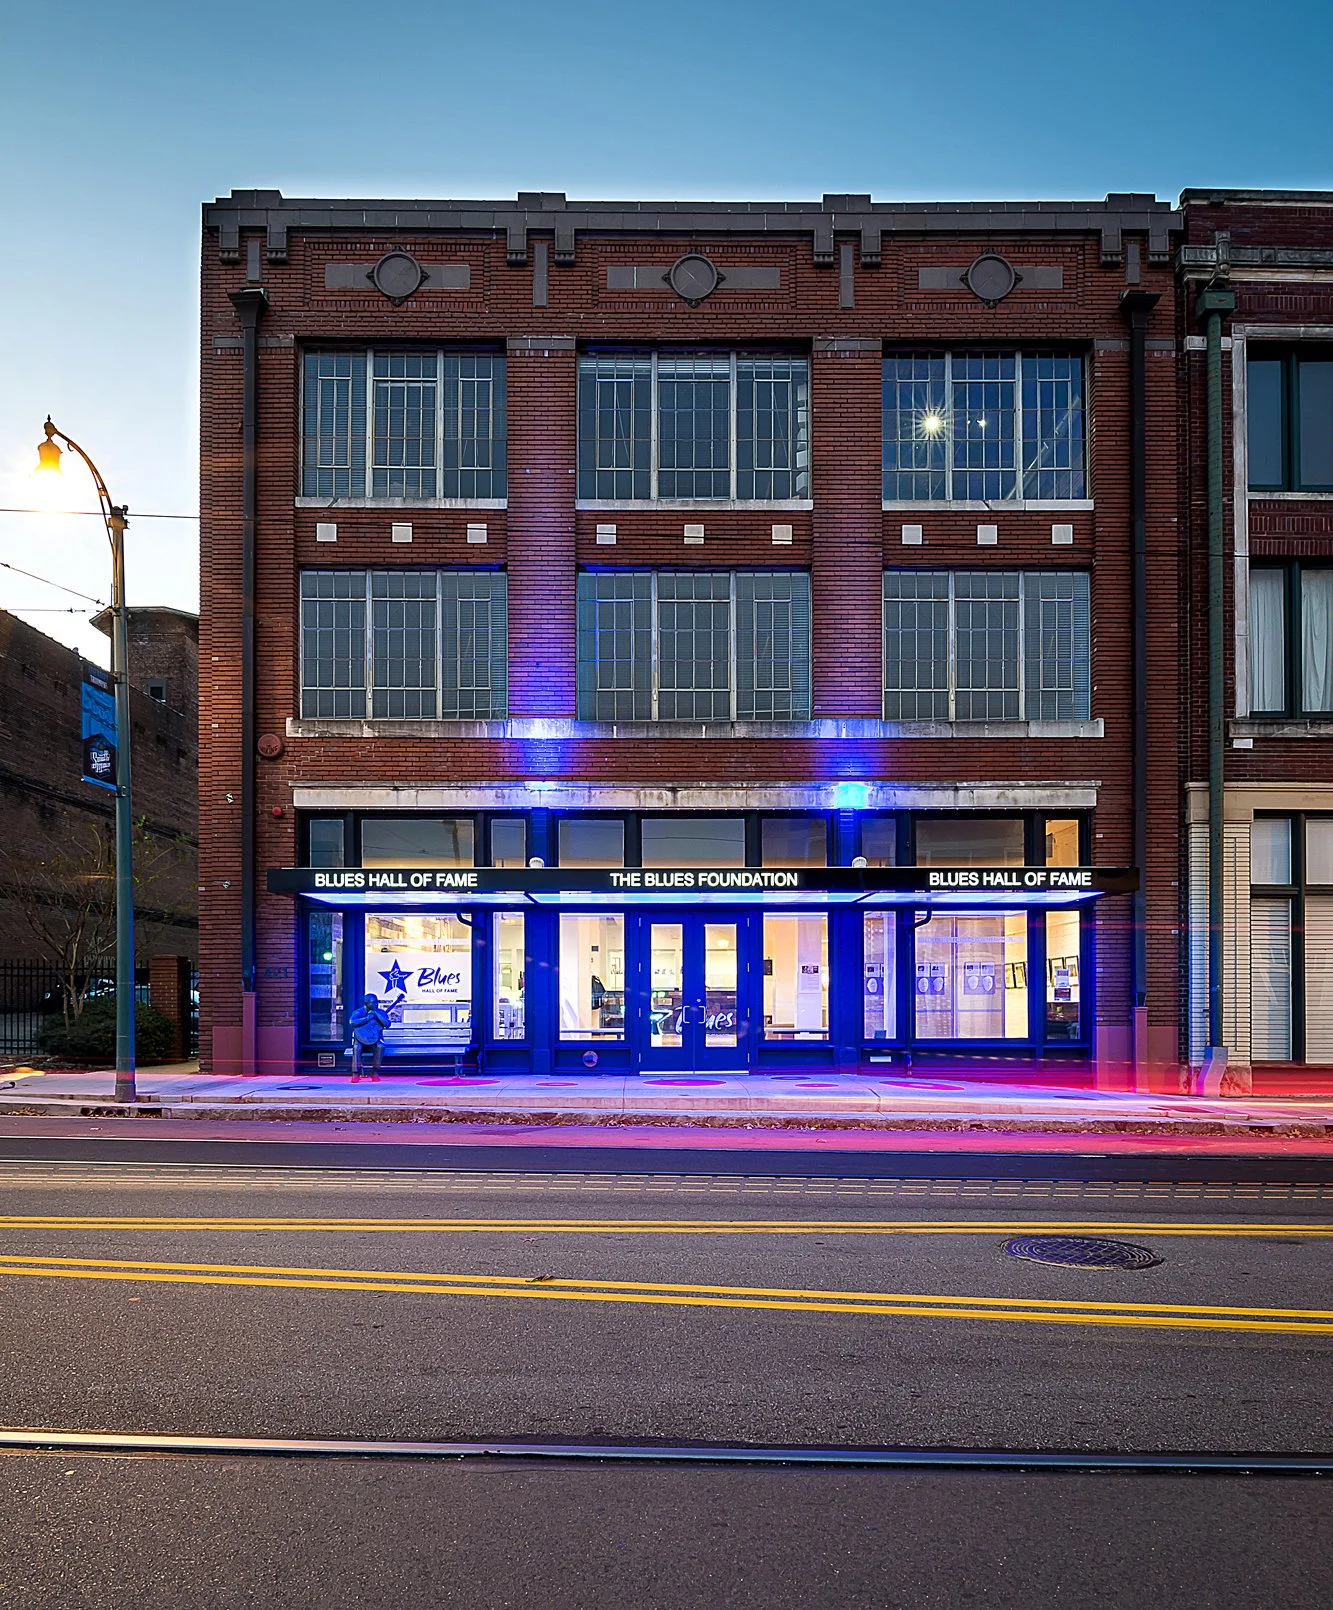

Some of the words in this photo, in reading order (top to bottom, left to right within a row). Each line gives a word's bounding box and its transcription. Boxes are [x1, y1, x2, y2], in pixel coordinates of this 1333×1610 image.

[315, 873, 365, 887] BLUES
[369, 873, 407, 887] HALL
[410, 873, 432, 887] OF
[436, 873, 477, 887] FAME
[610, 872, 641, 887] THE
[645, 872, 694, 887] BLUES
[698, 872, 798, 887] FOUNDATION
[929, 872, 979, 886] BLUES
[983, 872, 1021, 886] HALL
[1024, 872, 1046, 886] OF
[1050, 872, 1092, 886] FAME
[417, 967, 461, 987] Blues
